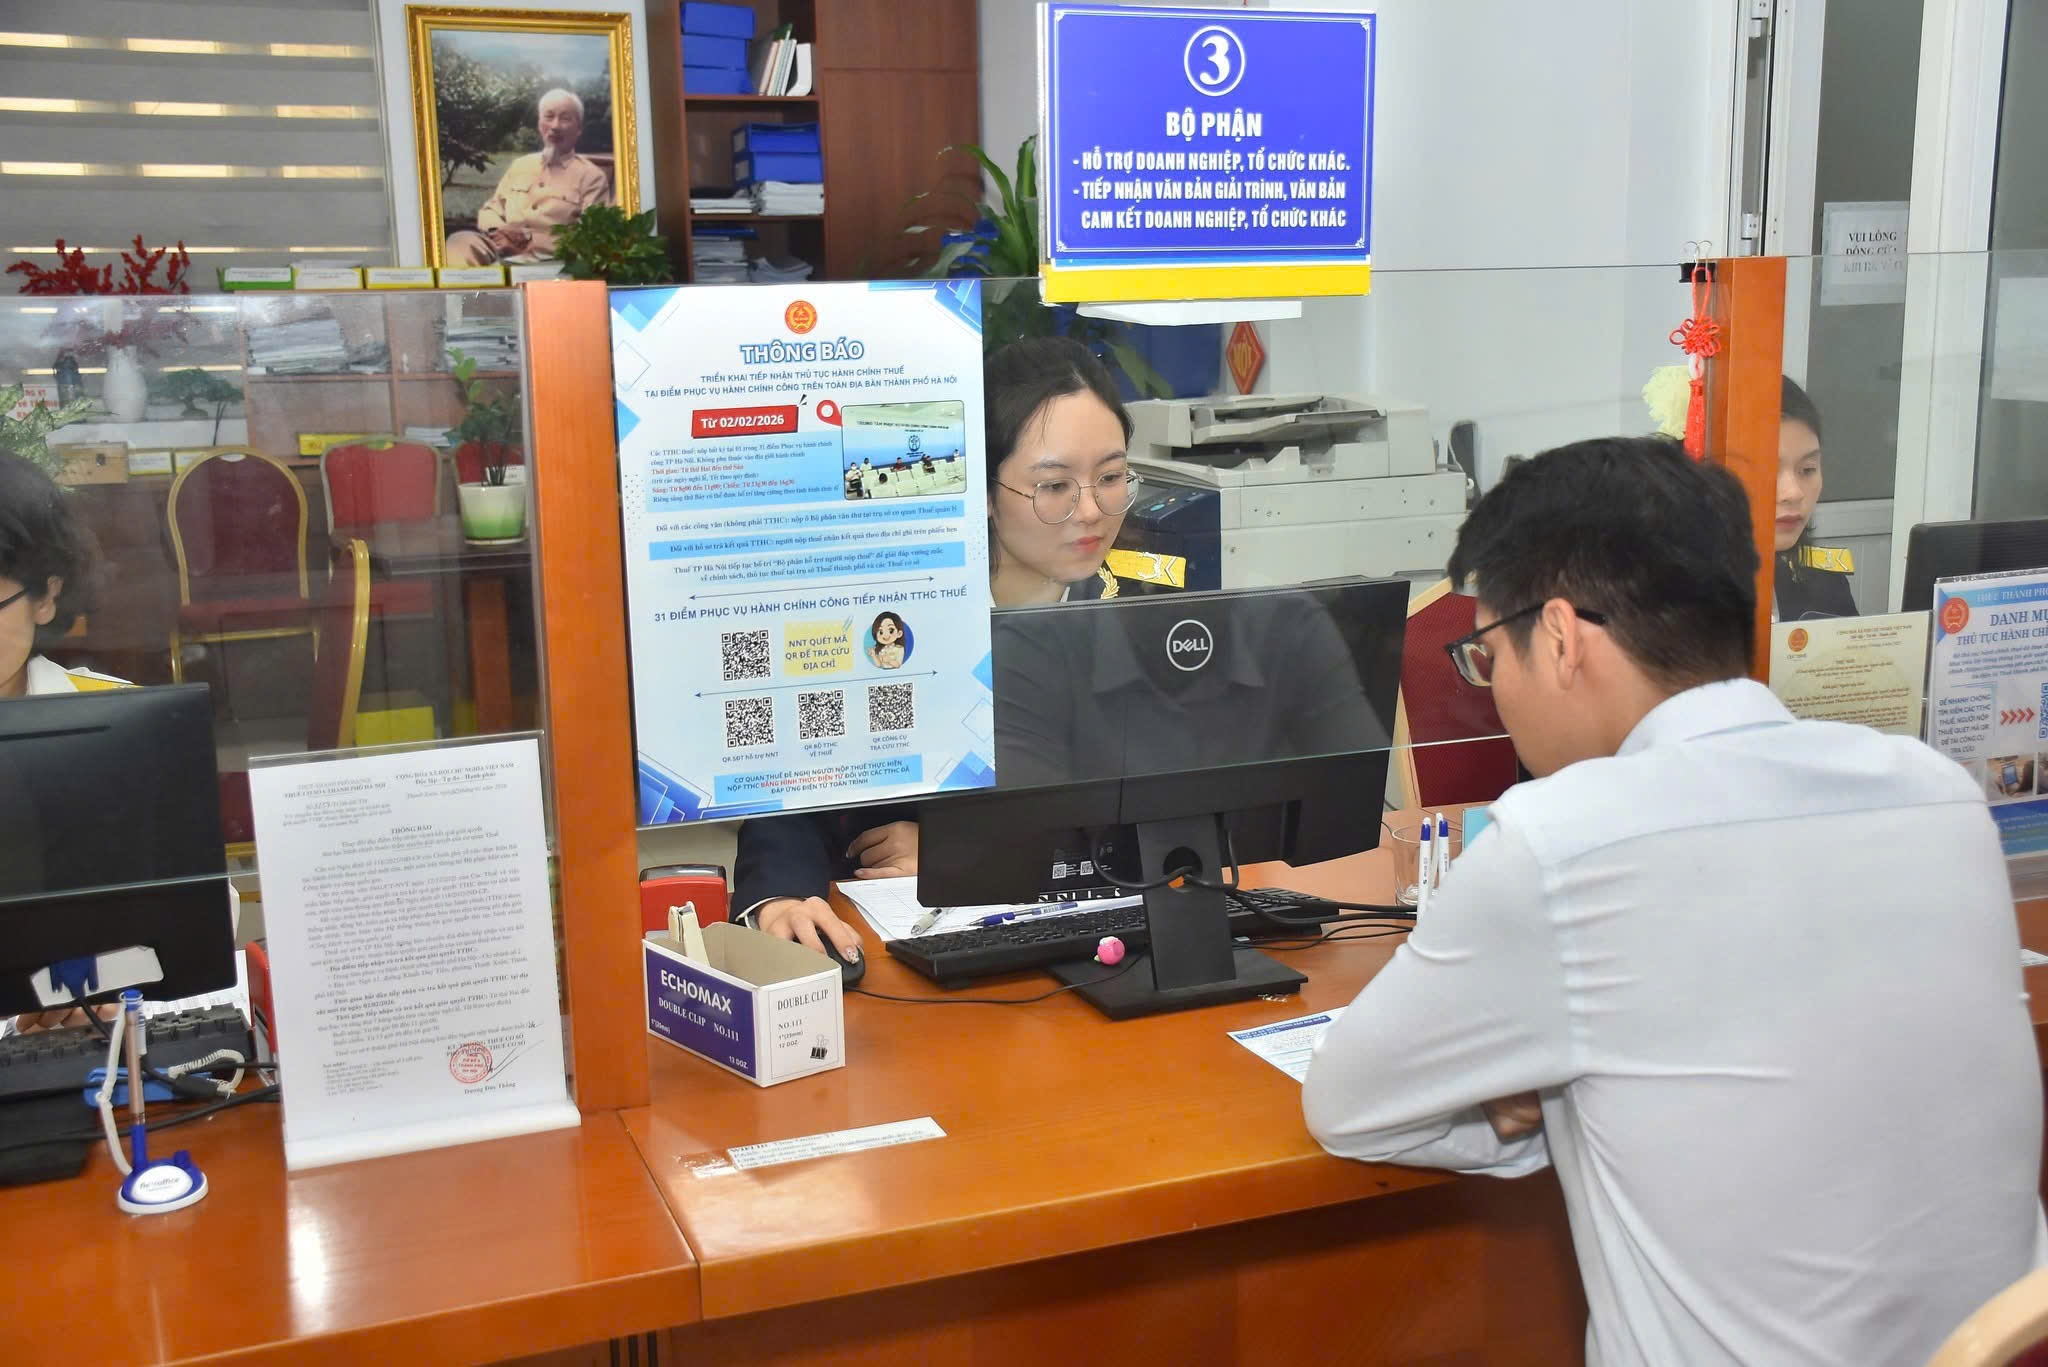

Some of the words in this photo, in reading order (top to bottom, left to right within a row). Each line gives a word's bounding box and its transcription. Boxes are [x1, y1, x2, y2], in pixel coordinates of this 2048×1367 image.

[1199, 35, 1231, 85] 3
[1166, 107, 1195, 141] BỘ
[1201, 108, 1262, 141] PHẬN
[1082, 146, 1102, 170] HỖ
[1105, 151, 1133, 173] TRỢ
[1136, 152, 1185, 170] DOANH
[1188, 150, 1243, 173] NGHIỆP,
[1247, 147, 1265, 170] TỔ
[1267, 150, 1305, 170] CHỨC
[1308, 150, 1350, 170] KHÁC.
[1081, 176, 1112, 199] TIẾP
[1114, 178, 1152, 202] NHẬN
[1155, 179, 1182, 199] VĂN
[1184, 176, 1212, 199] BẢN
[1214, 176, 1242, 199] GIẢI
[1244, 179, 1287, 200] TRÌNH,
[1290, 179, 1316, 198] VĂN
[1318, 176, 1345, 198] BẢN
[1081, 210, 1113, 229] CAM
[1116, 206, 1142, 228] KẾT
[1145, 210, 1192, 228] DOANH
[1195, 207, 1248, 230] NGHIỆP,
[1251, 204, 1268, 227] TỔ
[1271, 207, 1307, 227] CHỨC
[1310, 207, 1346, 227] KHÁC
[1848, 232, 1866, 242] VUI
[1869, 230, 1897, 242] LÒNG
[740, 339, 816, 364] THÔNG
[820, 336, 864, 361] BÁO
[700, 372, 725, 382] TRIỂN
[749, 371, 767, 380] TIẾP
[770, 370, 792, 379] NHẬN
[795, 368, 811, 378] THỦ
[831, 368, 854, 377] HÀNH
[856, 368, 881, 376] CHÍNH
[883, 365, 904, 374] THUẾ
[660, 385, 681, 397] ĐIỂM
[683, 387, 706, 396] PHỤC
[708, 387, 720, 395] VỤ
[722, 385, 745, 394] HÀNH
[747, 384, 773, 393] CHÍNH
[775, 382, 799, 391] CÔNG
[801, 381, 823, 390] TRÊN
[849, 380, 863, 388] ĐỊA
[864, 379, 881, 387] BÀN
[883, 378, 910, 386] THÀNH
[912, 375, 929, 384] PHỐ
[700, 417, 718, 428] Từ
[719, 414, 784, 427] 02/02/2026
[654, 613, 665, 622] 31
[670, 607, 696, 620] ĐIỂM
[700, 607, 729, 617] PHỤC
[733, 606, 747, 616] VỤ
[750, 602, 780, 613] HÀNH
[783, 599, 816, 611] CHÍNH
[819, 596, 849, 608] CÔNG
[852, 592, 875, 604] TIẾP
[878, 591, 907, 602] NHẬN
[910, 590, 936, 600] TTHC
[940, 585, 966, 597] THUẾ
[1990, 611, 2028, 626] DANH
[788, 639, 806, 647] NNT
[809, 637, 831, 646] QUÉT
[833, 634, 847, 643] MÃ
[1172, 638, 1209, 654] DELL
[1957, 632, 1977, 646] THỦ
[1980, 633, 1998, 645] TỤC
[2000, 628, 2029, 640] HÀNH
[785, 652, 798, 660] QR
[799, 649, 810, 658] ĐỂ
[812, 649, 829, 657] TRA
[830, 647, 849, 656] CỨU
[803, 662, 818, 670] ĐỊA
[820, 658, 835, 668] CHỈ
[745, 775, 764, 783] QUAN
[661, 970, 731, 1014] ECHOMAX
[777, 994, 809, 1010] DOUBLE
[811, 989, 828, 1002] CLIP
[658, 997, 686, 1017] DOUBLE
[688, 1011, 706, 1026] CLIP
[714, 1022, 740, 1042] NO.111
[778, 1018, 802, 1030] NO.111
[729, 1055, 735, 1064] 12
